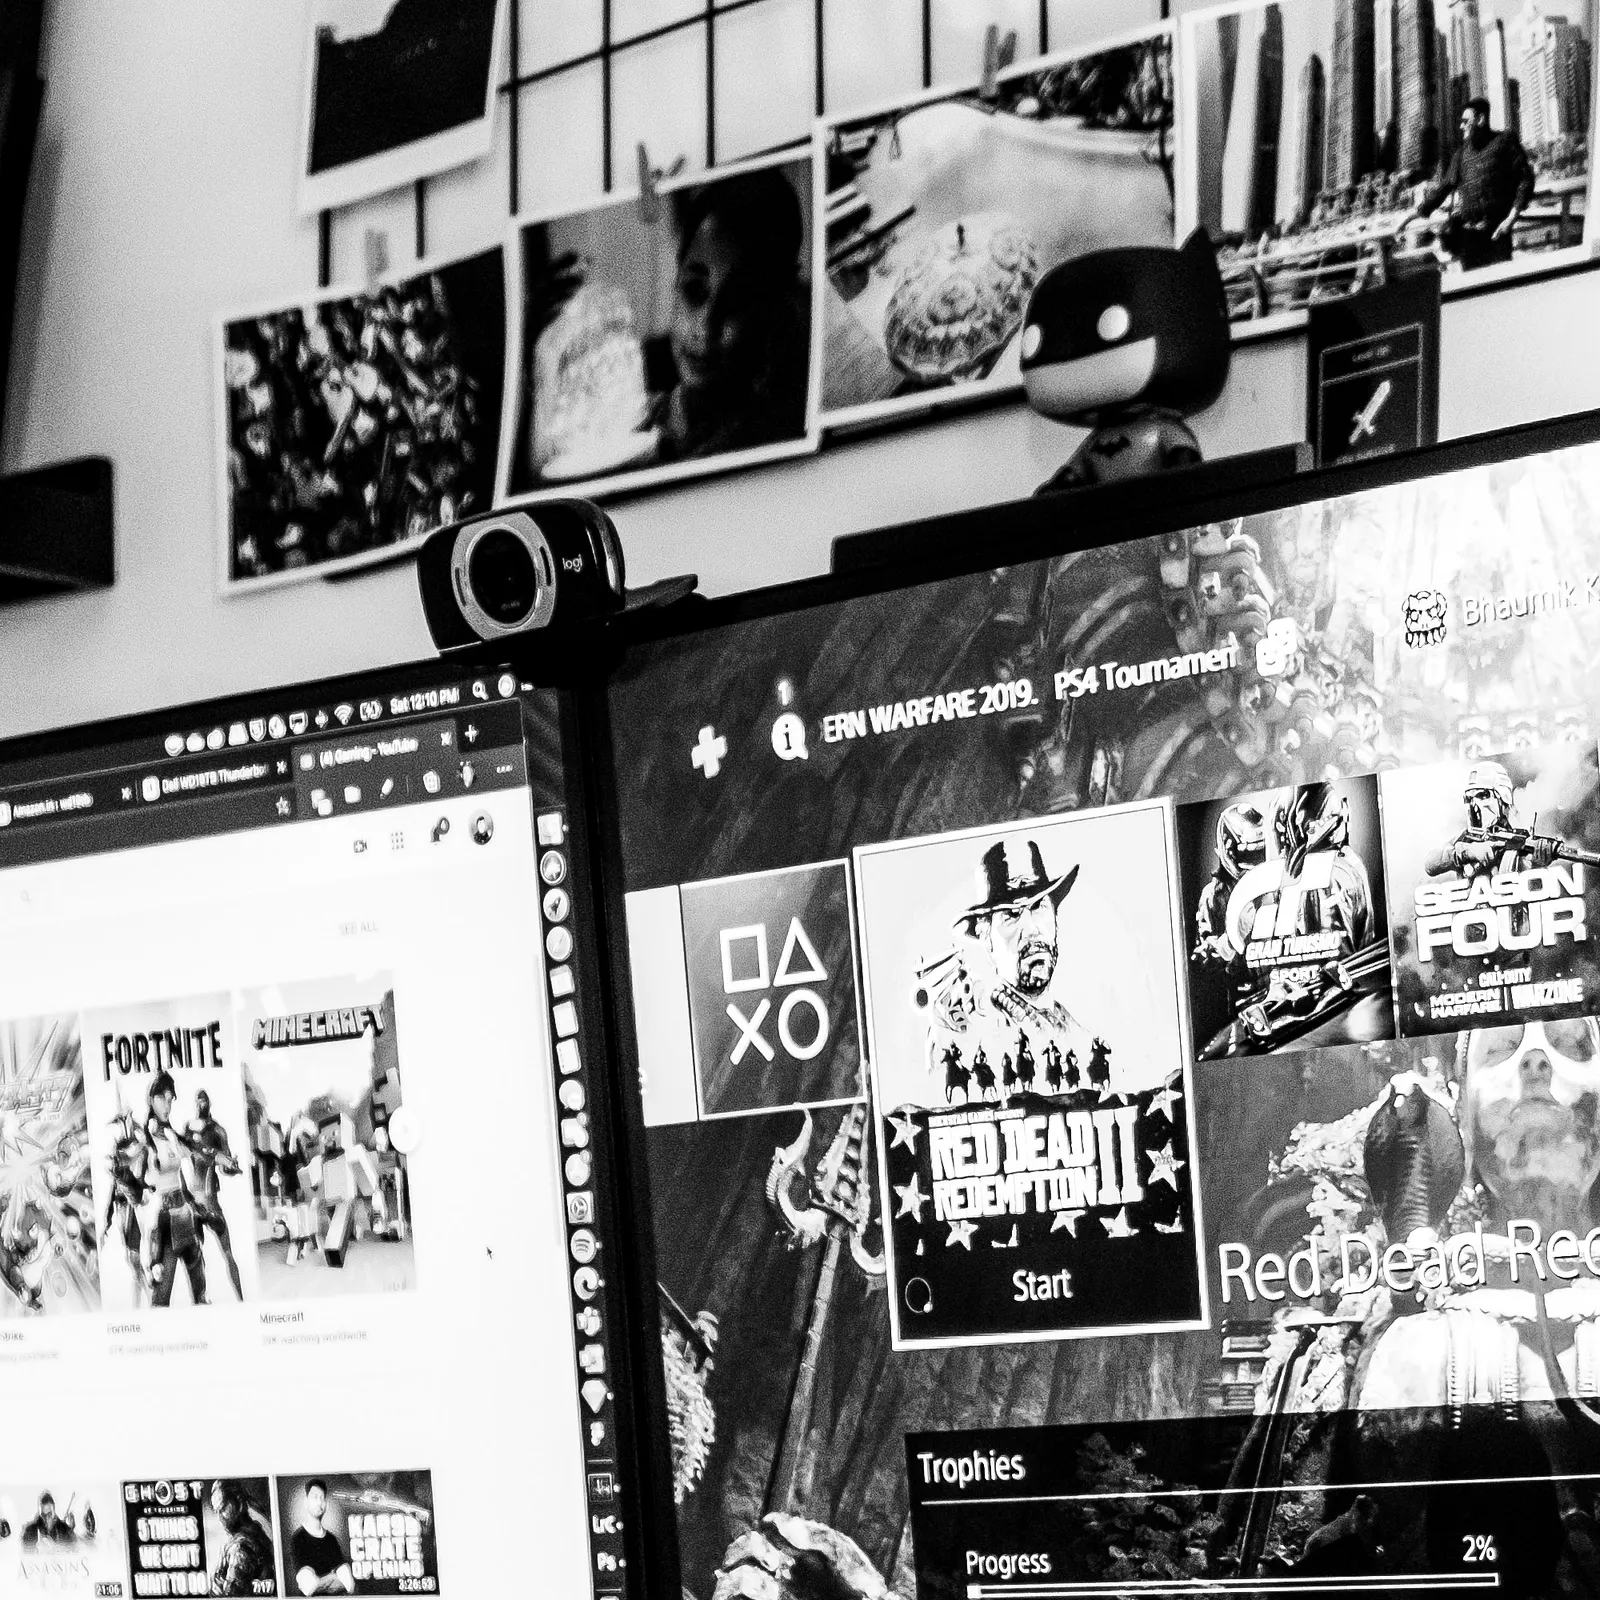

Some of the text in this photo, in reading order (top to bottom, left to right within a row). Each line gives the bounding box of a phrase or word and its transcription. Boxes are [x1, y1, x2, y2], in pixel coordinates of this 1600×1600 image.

[822, 710, 867, 744] ERN
[868, 689, 976, 735] WARFARE
[978, 677, 1039, 716] 2019.
[1053, 666, 1100, 701] PS4
[1414, 861, 1586, 918] SEASON
[1414, 896, 1587, 963] FOUR
[1429, 986, 1501, 1008] MODERN
[1430, 999, 1502, 1020] WARFARE
[1510, 977, 1584, 1010] WARZONE
[251, 1002, 385, 1051] MINECRAFT
[100, 1020, 223, 1081] FORTNITE
[928, 1105, 1144, 1205] RED DEAD II
[932, 1165, 1099, 1221] REDEMPTION
[1012, 1267, 1074, 1303] Start
[1218, 1240, 1322, 1304] Red
[1340, 1222, 1488, 1295] Dead
[258, 1311, 305, 1325] Minecraft
[917, 1449, 1026, 1490] Trophies
[124, 1479, 204, 1506] GHOST
[349, 1535, 423, 1562] CRATE
[965, 1533, 1498, 1578] Progress 2%
